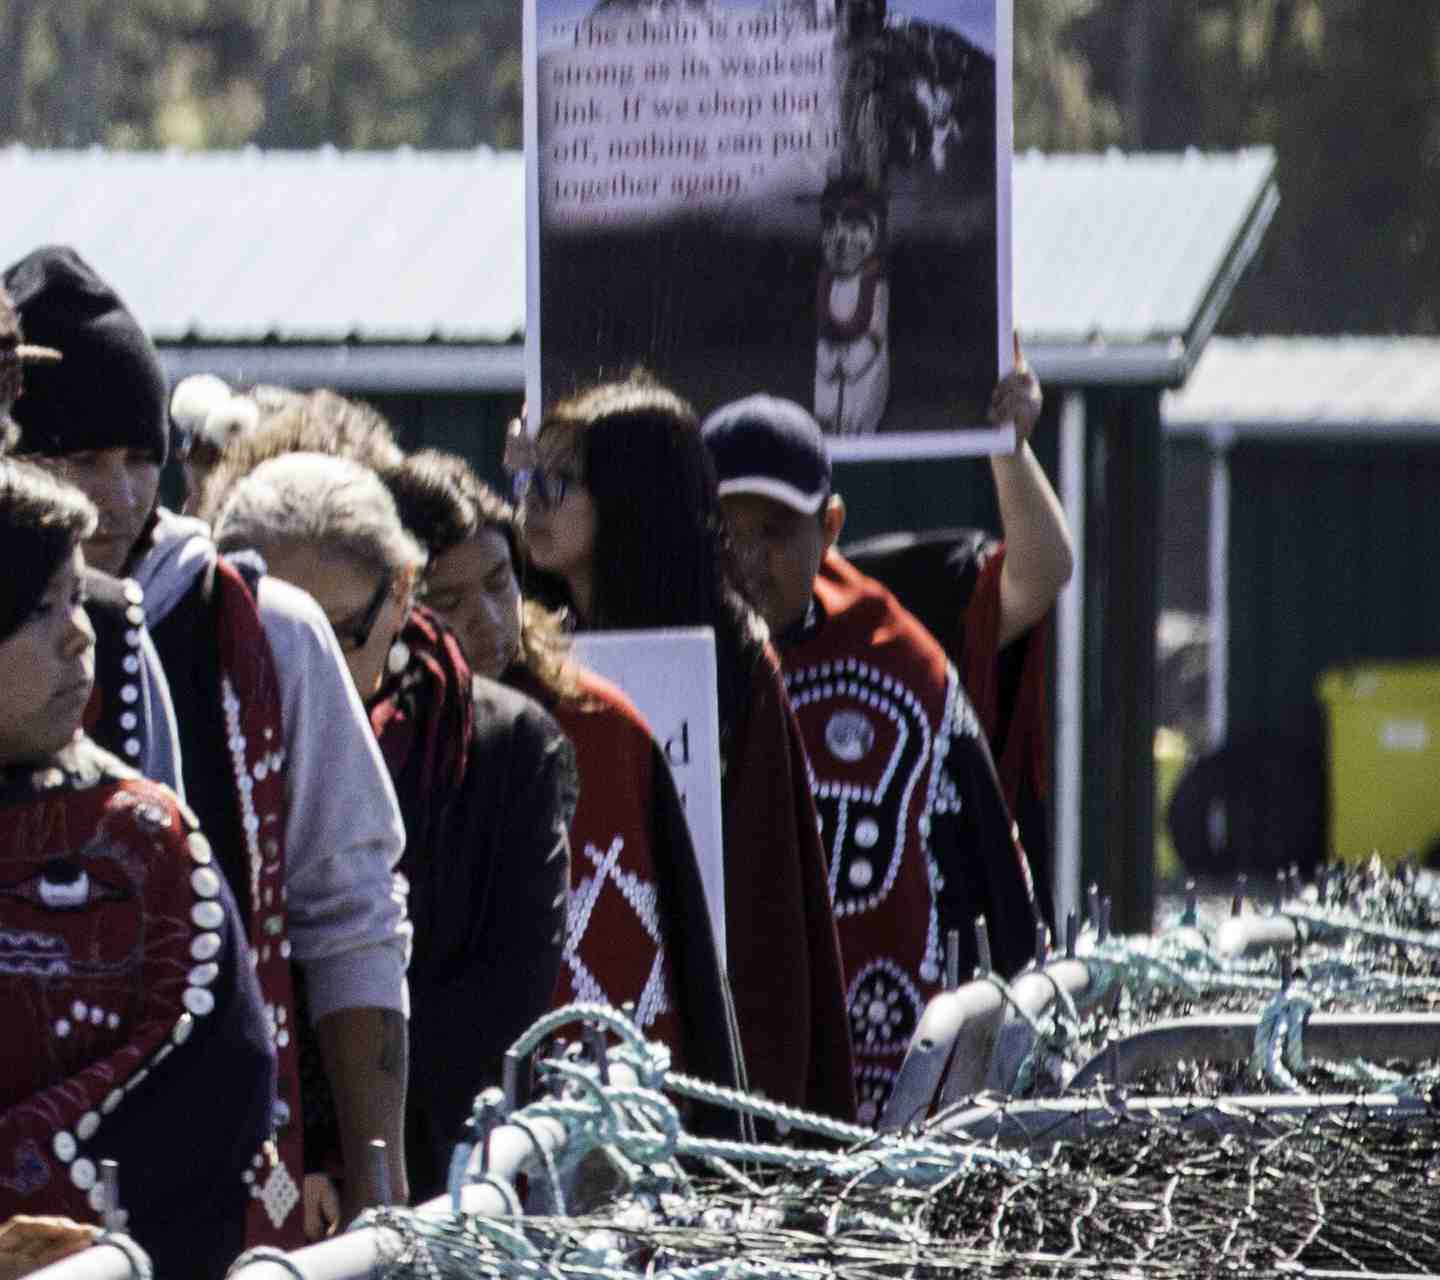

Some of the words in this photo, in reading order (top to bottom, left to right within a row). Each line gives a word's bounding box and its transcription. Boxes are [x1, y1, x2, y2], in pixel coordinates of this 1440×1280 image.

[625, 18, 698, 46] chain
[708, 17, 729, 41] is
[737, 13, 793, 42] only
[552, 64, 633, 88] strong
[643, 64, 671, 82] as
[681, 55, 711, 81] its
[720, 49, 827, 78] weakest
[621, 95, 645, 122] If
[652, 101, 690, 118] we
[698, 90, 764, 121] chop
[771, 89, 820, 115] that
[553, 136, 600, 164] off,
[608, 130, 708, 162] nothing
[717, 134, 764, 153] can
[771, 129, 813, 158] put
[553, 171, 660, 205] together
